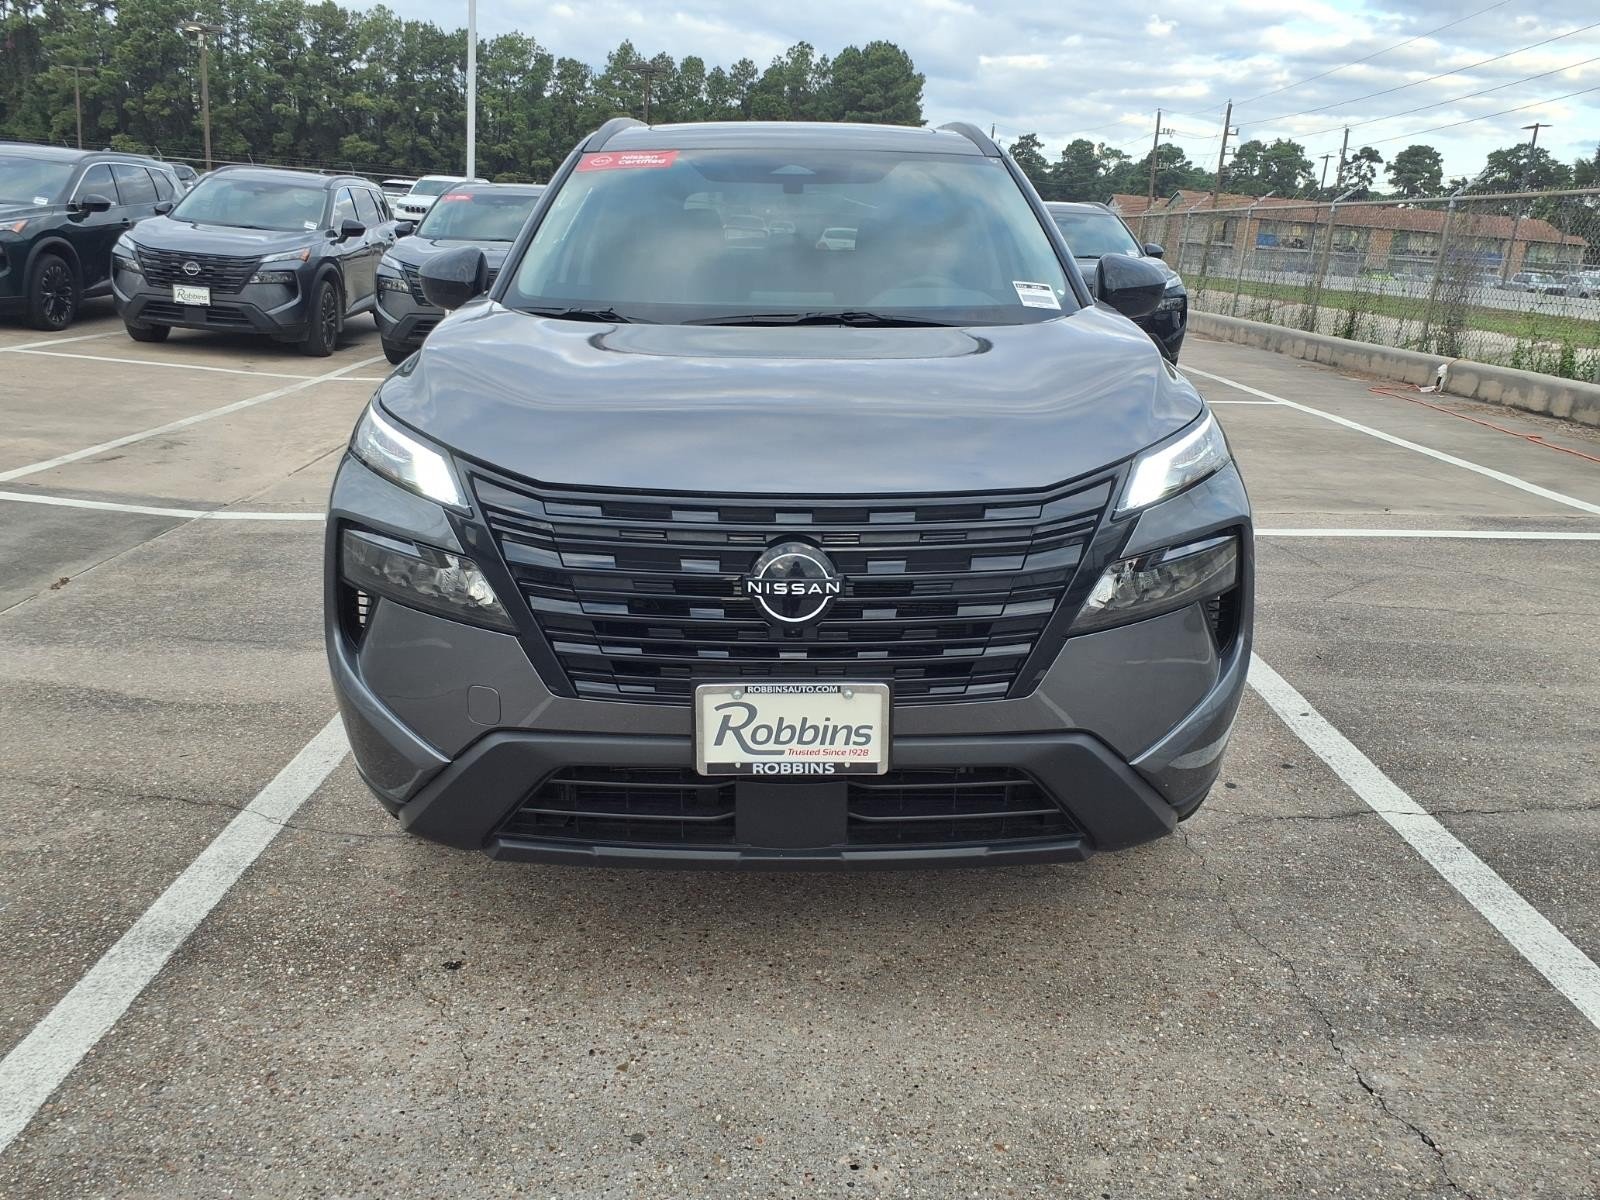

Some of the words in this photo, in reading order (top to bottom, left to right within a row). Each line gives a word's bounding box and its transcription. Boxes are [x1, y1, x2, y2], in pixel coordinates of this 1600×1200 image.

[747, 581, 840, 595] NISSAN
[713, 701, 874, 756] Robbins
[788, 748, 820, 756] Trusted
[822, 748, 847, 756] Since
[849, 748, 869, 757] 1928
[752, 762, 835, 775] ROBBINS
